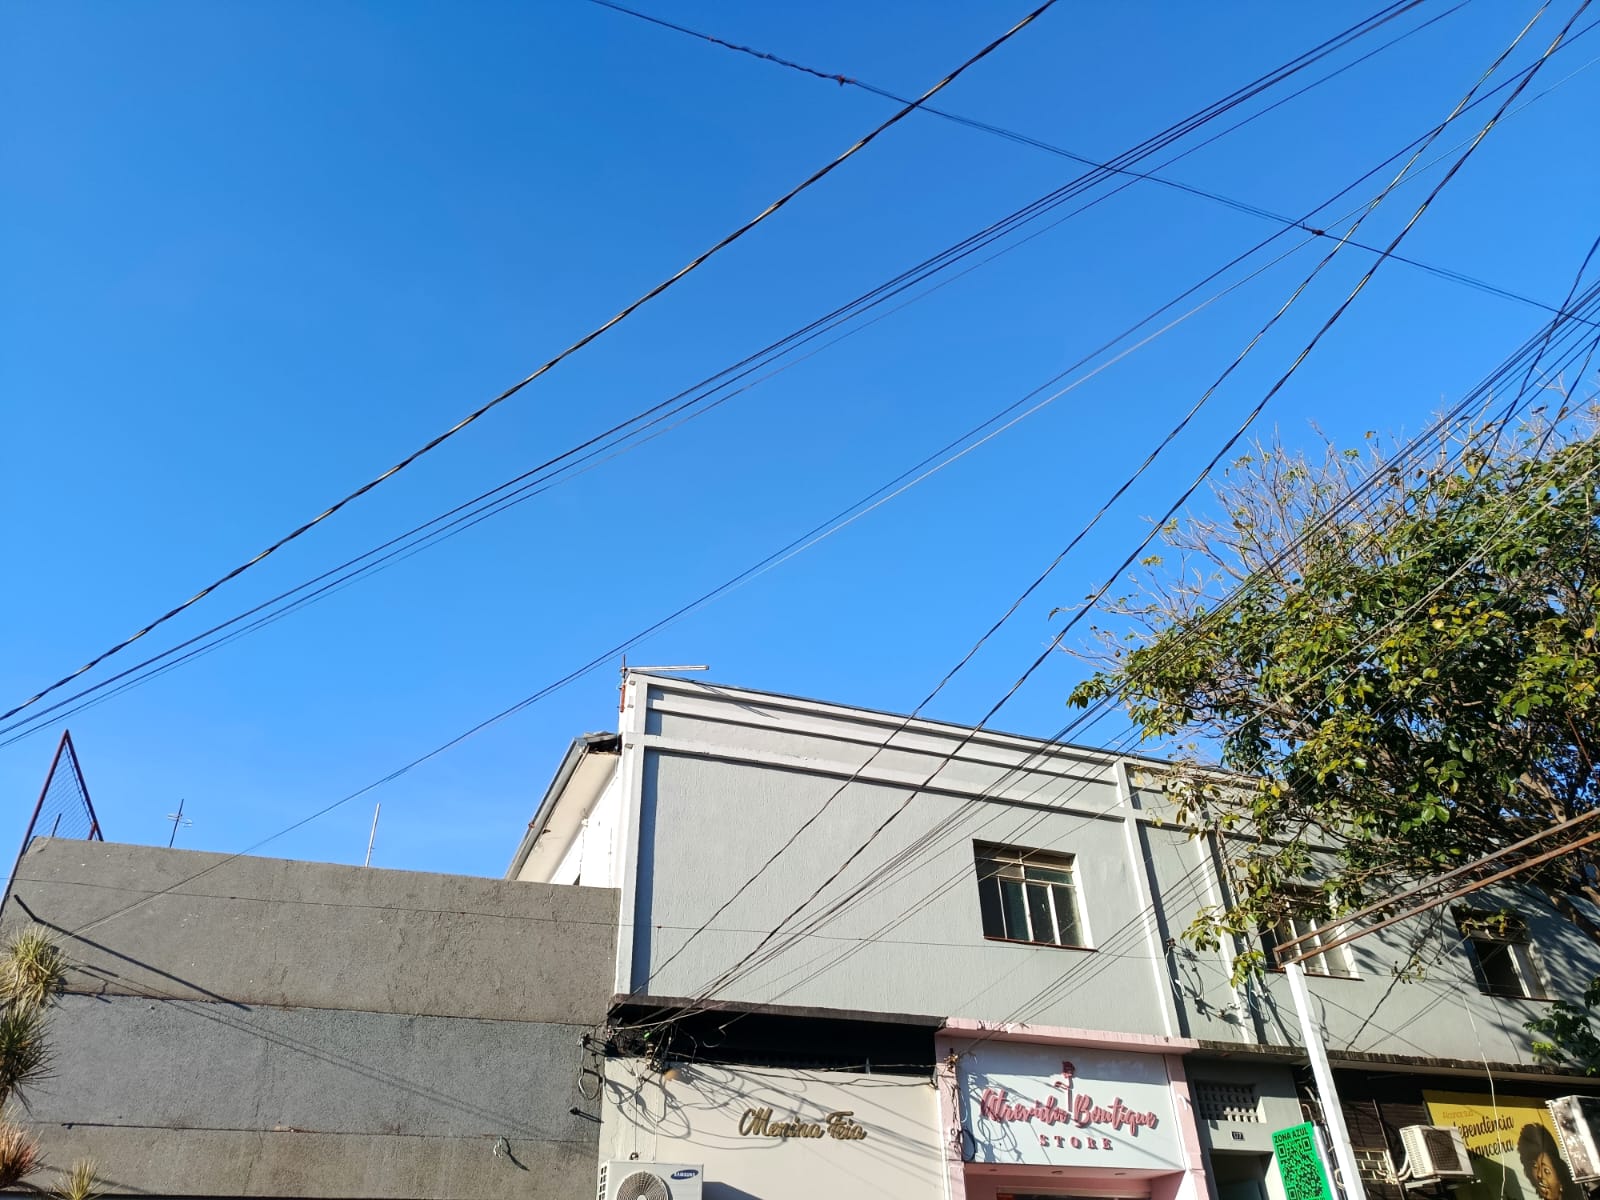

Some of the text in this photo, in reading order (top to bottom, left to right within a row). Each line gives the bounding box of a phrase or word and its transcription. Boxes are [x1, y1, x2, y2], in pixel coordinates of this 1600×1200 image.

[739, 1106, 868, 1140] Menina Feia
[1074, 1094, 1159, 1137] Boutique
[1039, 1134, 1113, 1150] STORE
[1274, 1127, 1309, 1143] ZONA AZUL
[1453, 1115, 1514, 1147] ependência
[1466, 1138, 1514, 1160] nanceira
